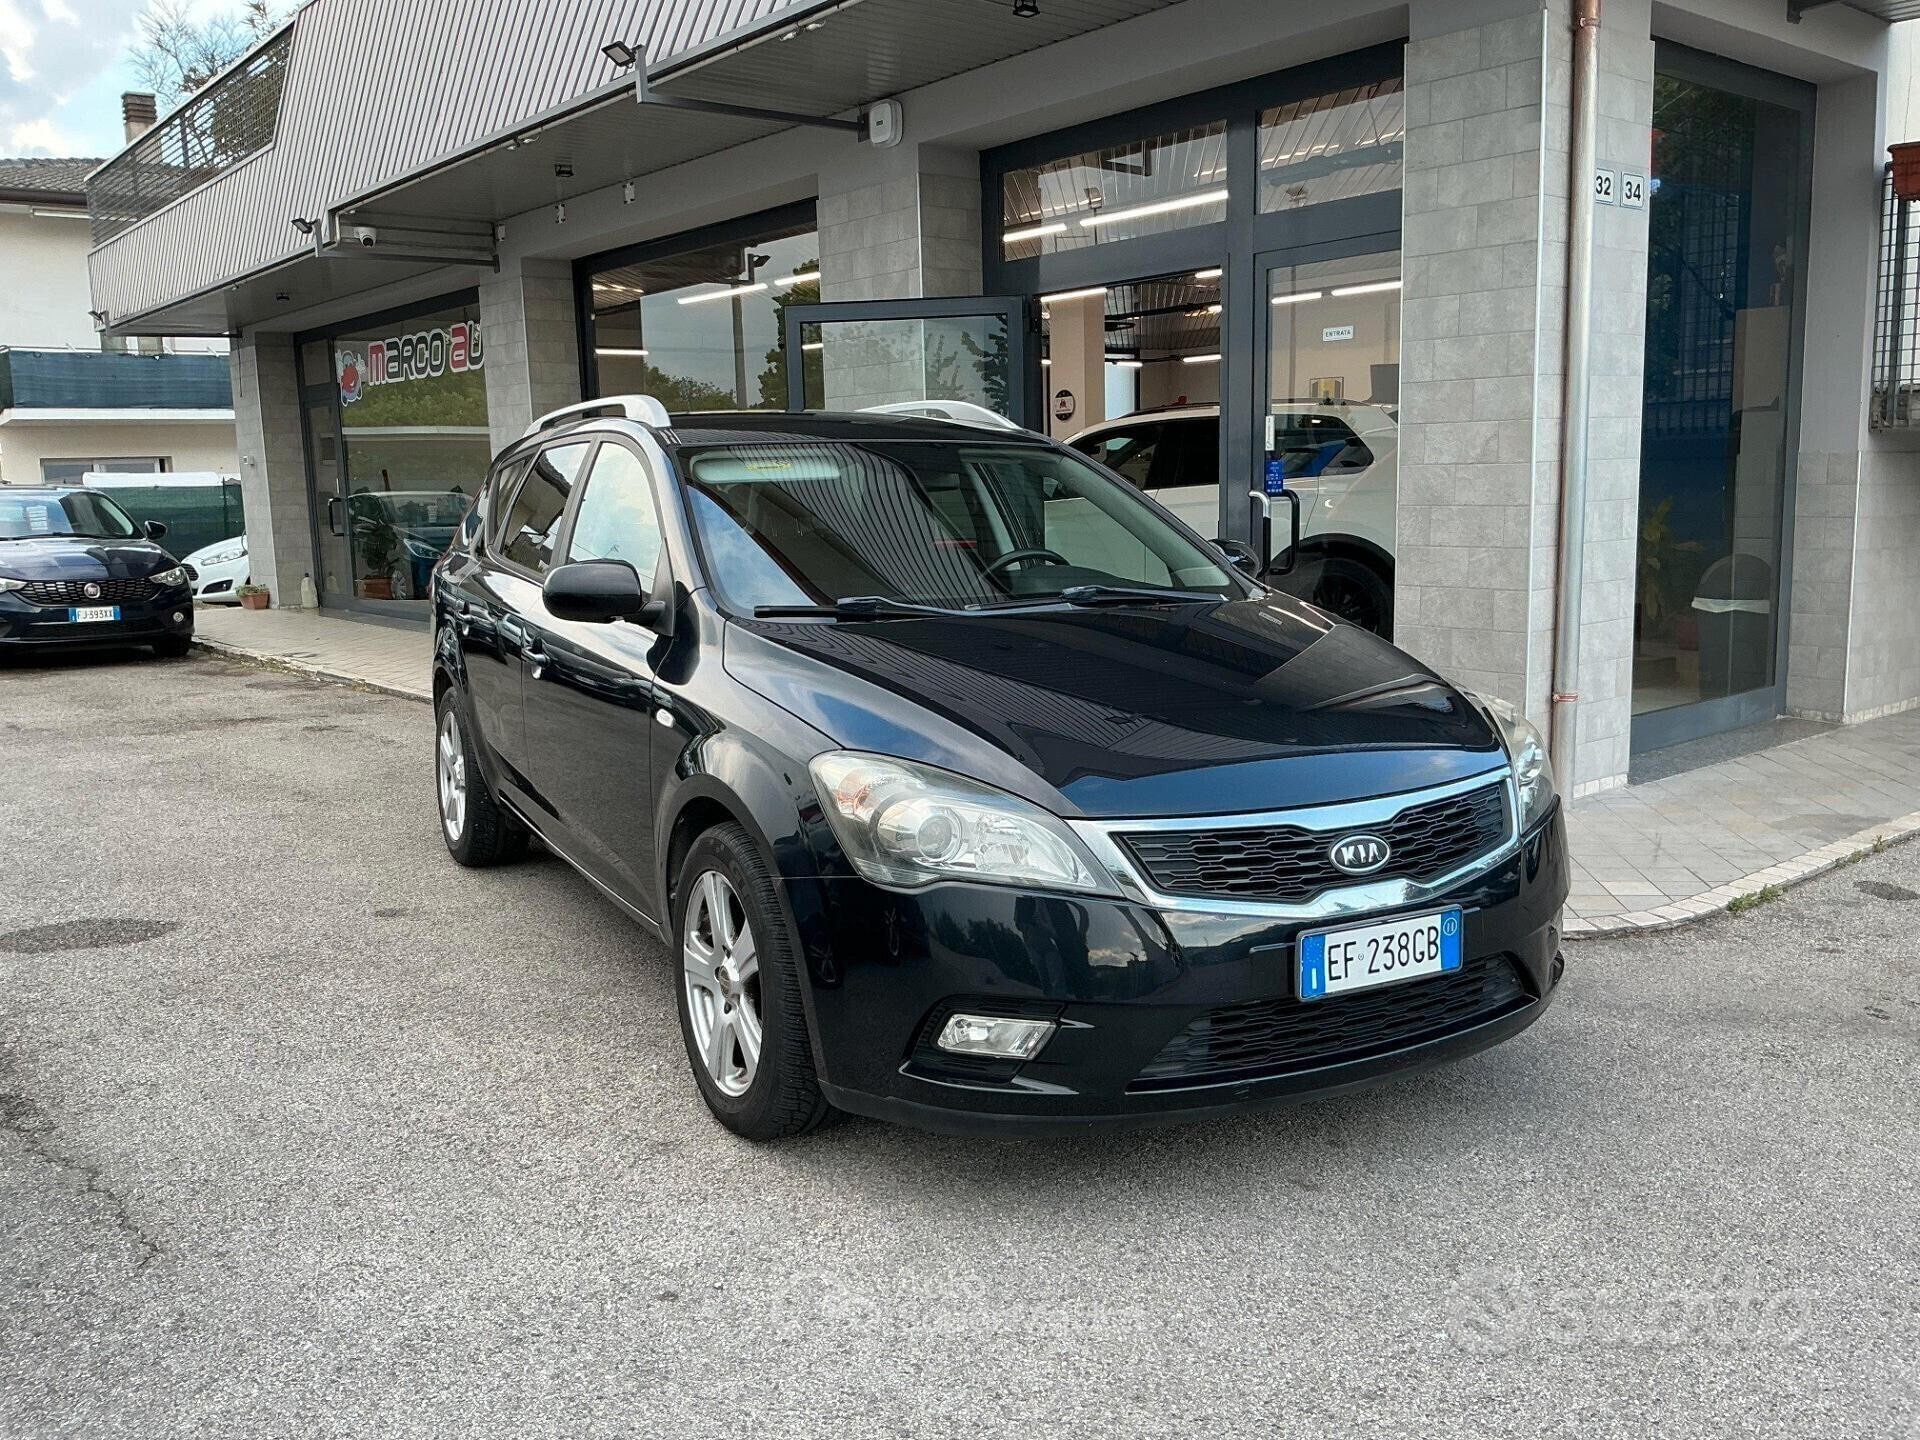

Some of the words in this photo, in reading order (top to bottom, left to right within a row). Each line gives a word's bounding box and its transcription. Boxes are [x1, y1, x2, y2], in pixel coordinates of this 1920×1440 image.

[1595, 175, 1611, 196] 32
[1625, 180, 1641, 201] 34
[1325, 329, 1351, 338] ENTRATA
[1340, 842, 1383, 866] KIA
[1328, 941, 1357, 982] EF
[1367, 926, 1439, 974] 238GB
